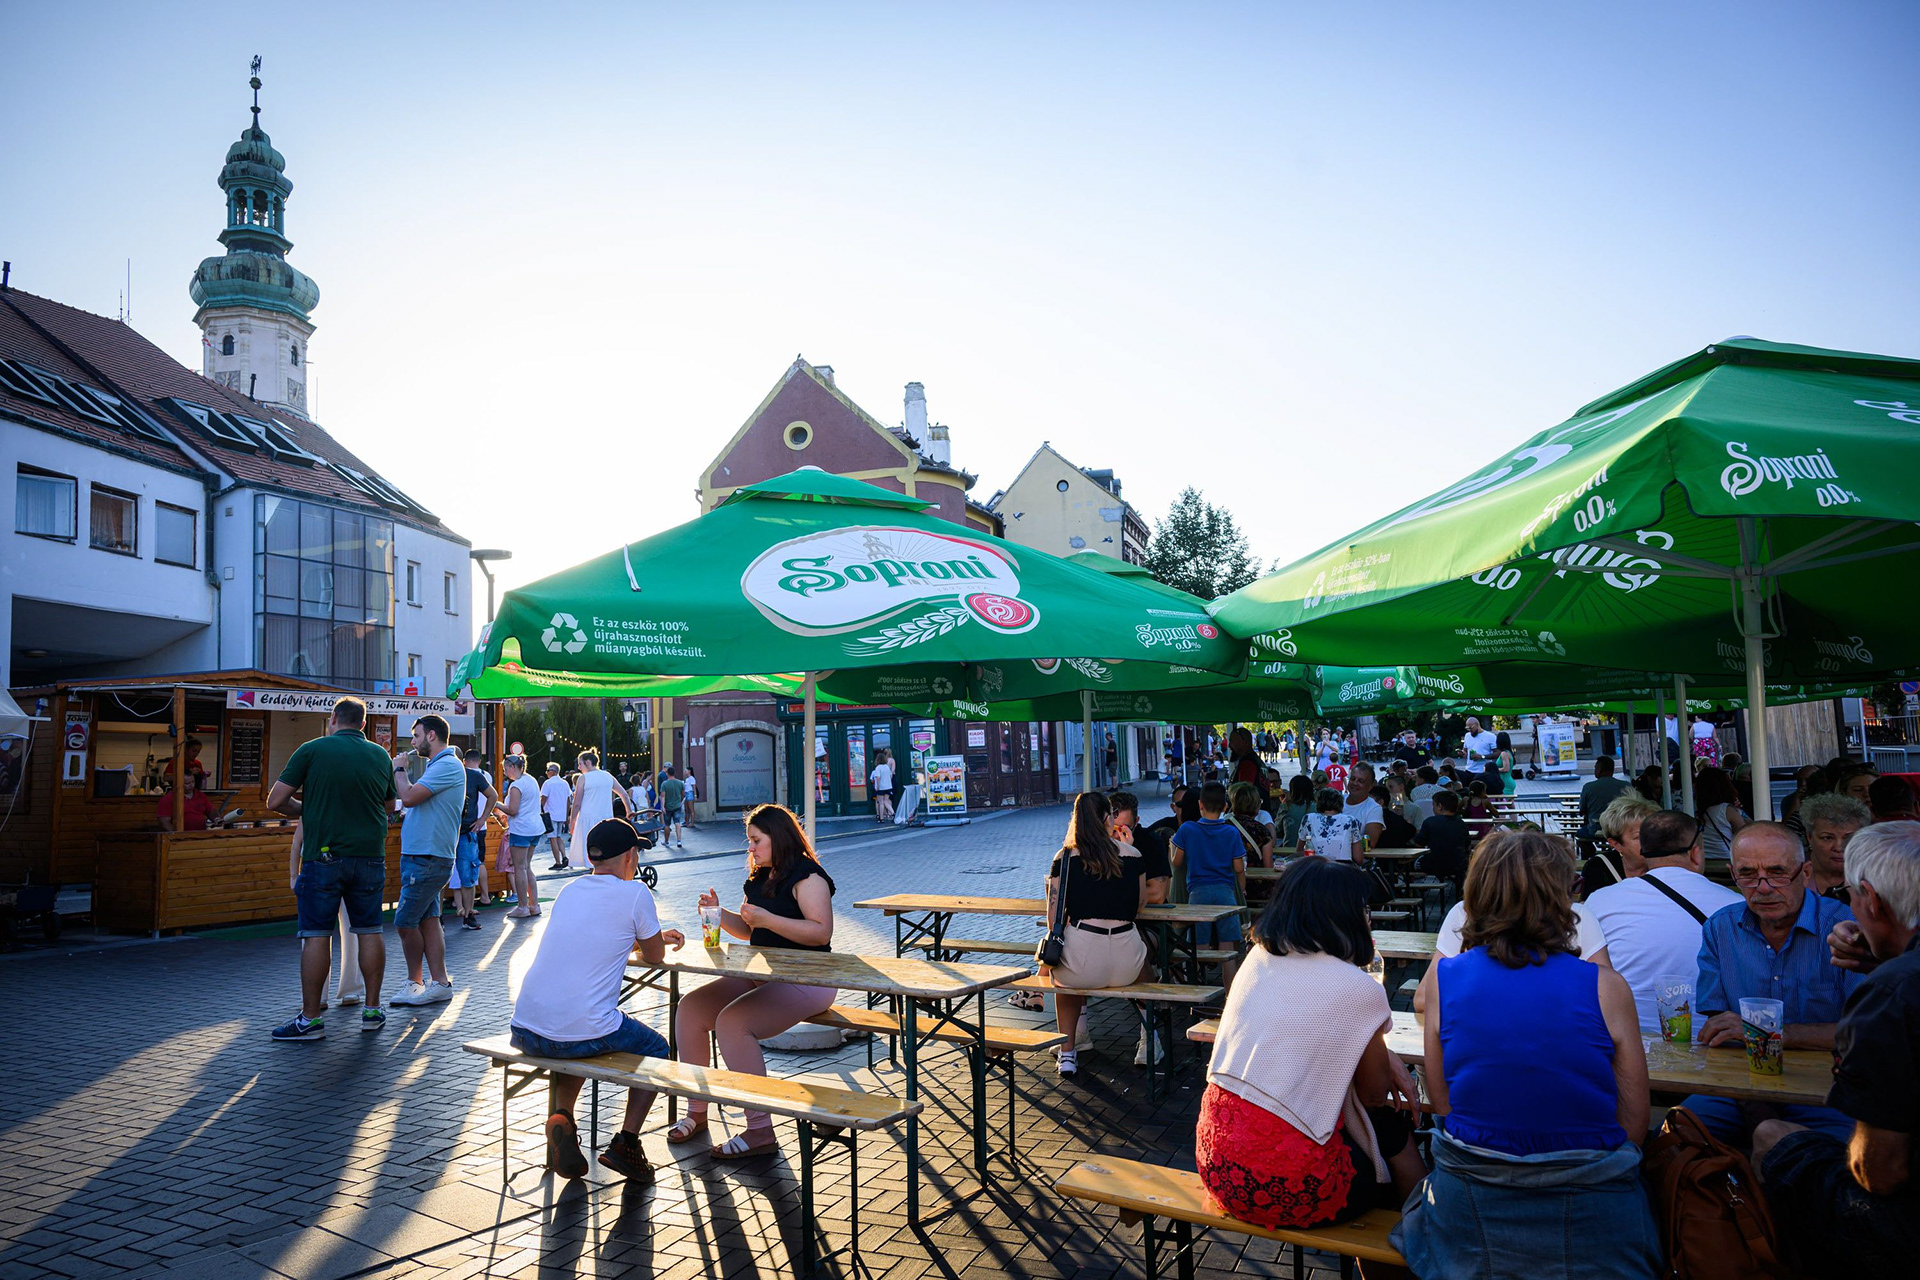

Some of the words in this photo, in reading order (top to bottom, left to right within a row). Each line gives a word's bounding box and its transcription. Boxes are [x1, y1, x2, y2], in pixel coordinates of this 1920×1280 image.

[1720, 441, 1839, 500] Soproni
[1816, 483, 1861, 507] 0.0%
[1573, 495, 1617, 532] 0.0%
[778, 555, 1000, 598] Soproni
[593, 617, 604, 627] Ez
[607, 620, 619, 629] az
[622, 620, 657, 631] eszköz
[660, 621, 689, 632] 100%
[594, 629, 682, 644] újrahasznosított
[1135, 623, 1197, 648] Soproni
[1175, 639, 1202, 650] 0.0%
[595, 642, 662, 657] műanyagból
[665, 646, 706, 657] készült.
[1264, 661, 1287, 675] 0.0%
[1339, 678, 1381, 702] Soproni
[260, 693, 303, 707] Erdélyi
[385, 700, 409, 710] Tomi
[411, 701, 445, 711] Kürtős
[1330, 768, 1341, 780] 12
